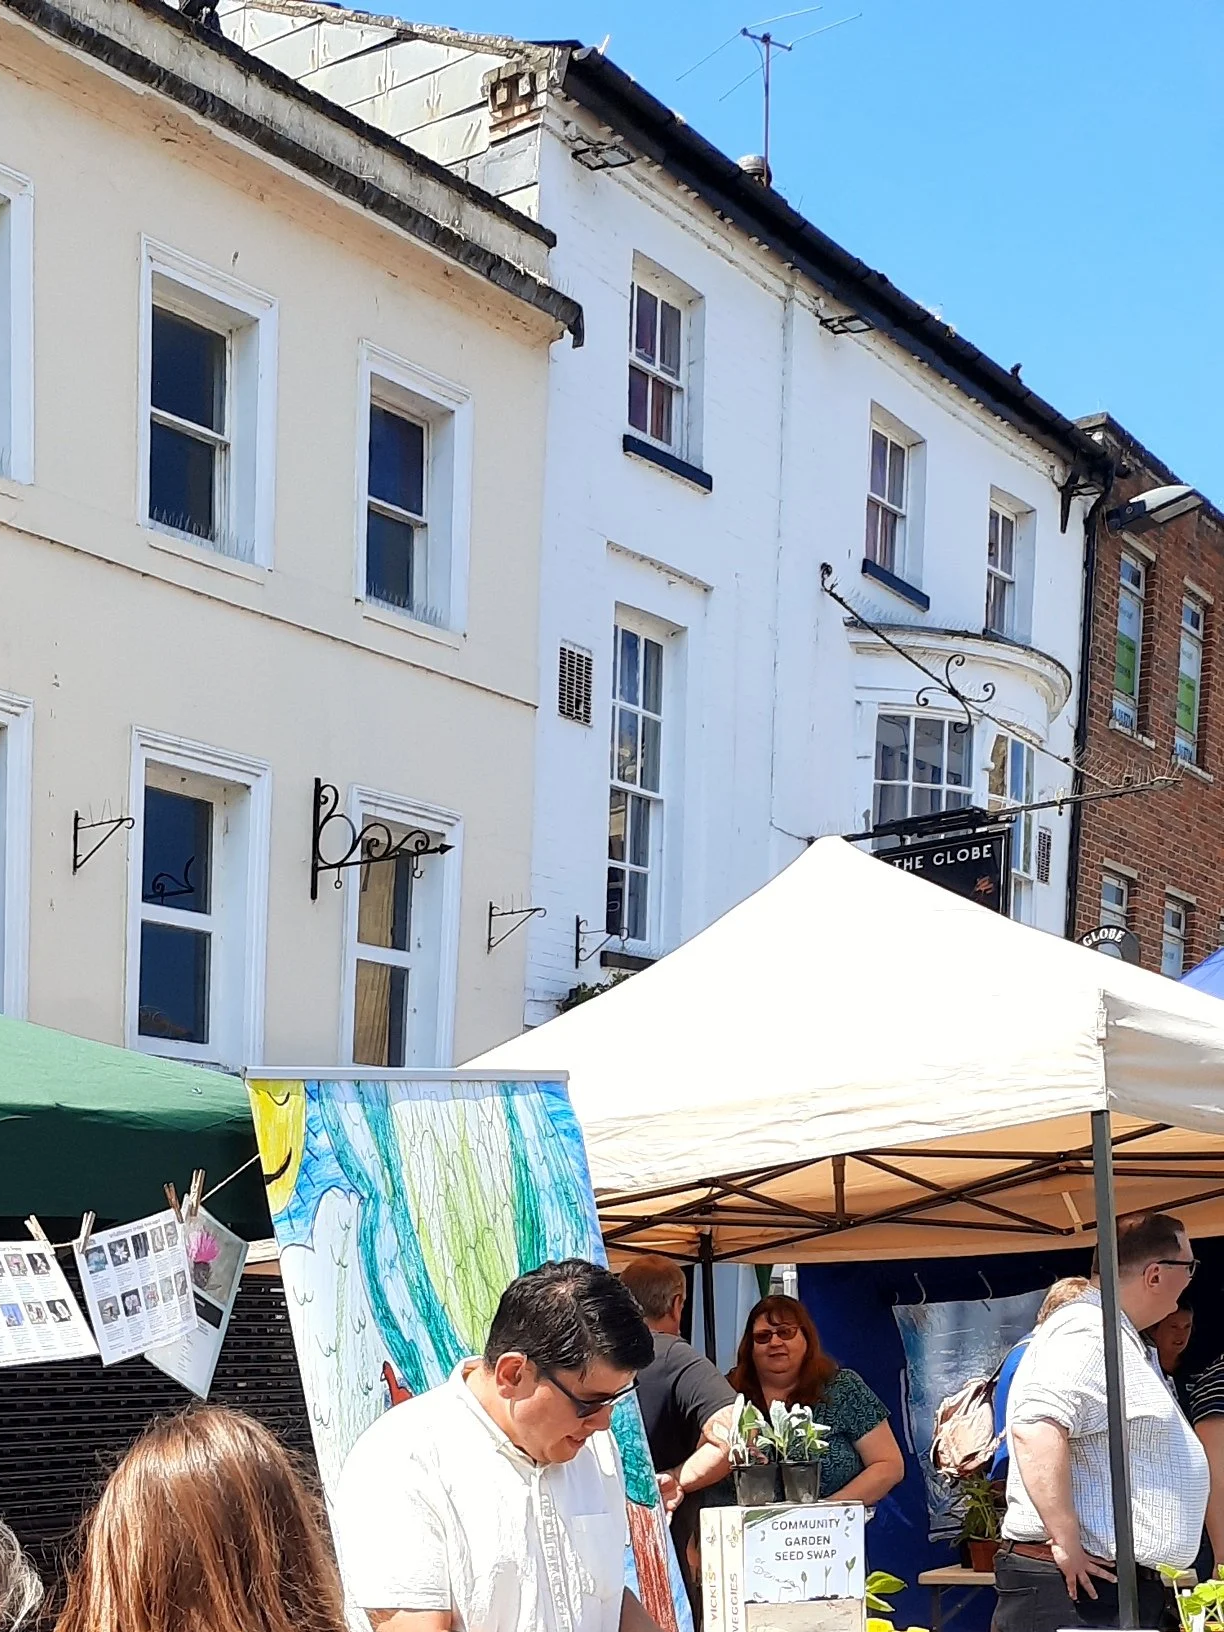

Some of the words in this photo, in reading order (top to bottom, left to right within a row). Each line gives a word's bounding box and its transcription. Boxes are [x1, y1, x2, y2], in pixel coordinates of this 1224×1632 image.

[893, 855, 924, 871] THE
[932, 844, 992, 866] GLOBE
[1082, 928, 1125, 947] GLOBE
[771, 1518, 841, 1531] COMMUNITY
[785, 1535, 831, 1547] GARDEN
[774, 1551, 804, 1561] SEED
[807, 1549, 837, 1560] SWAP
[730, 1572, 739, 1632] VEGGIES
